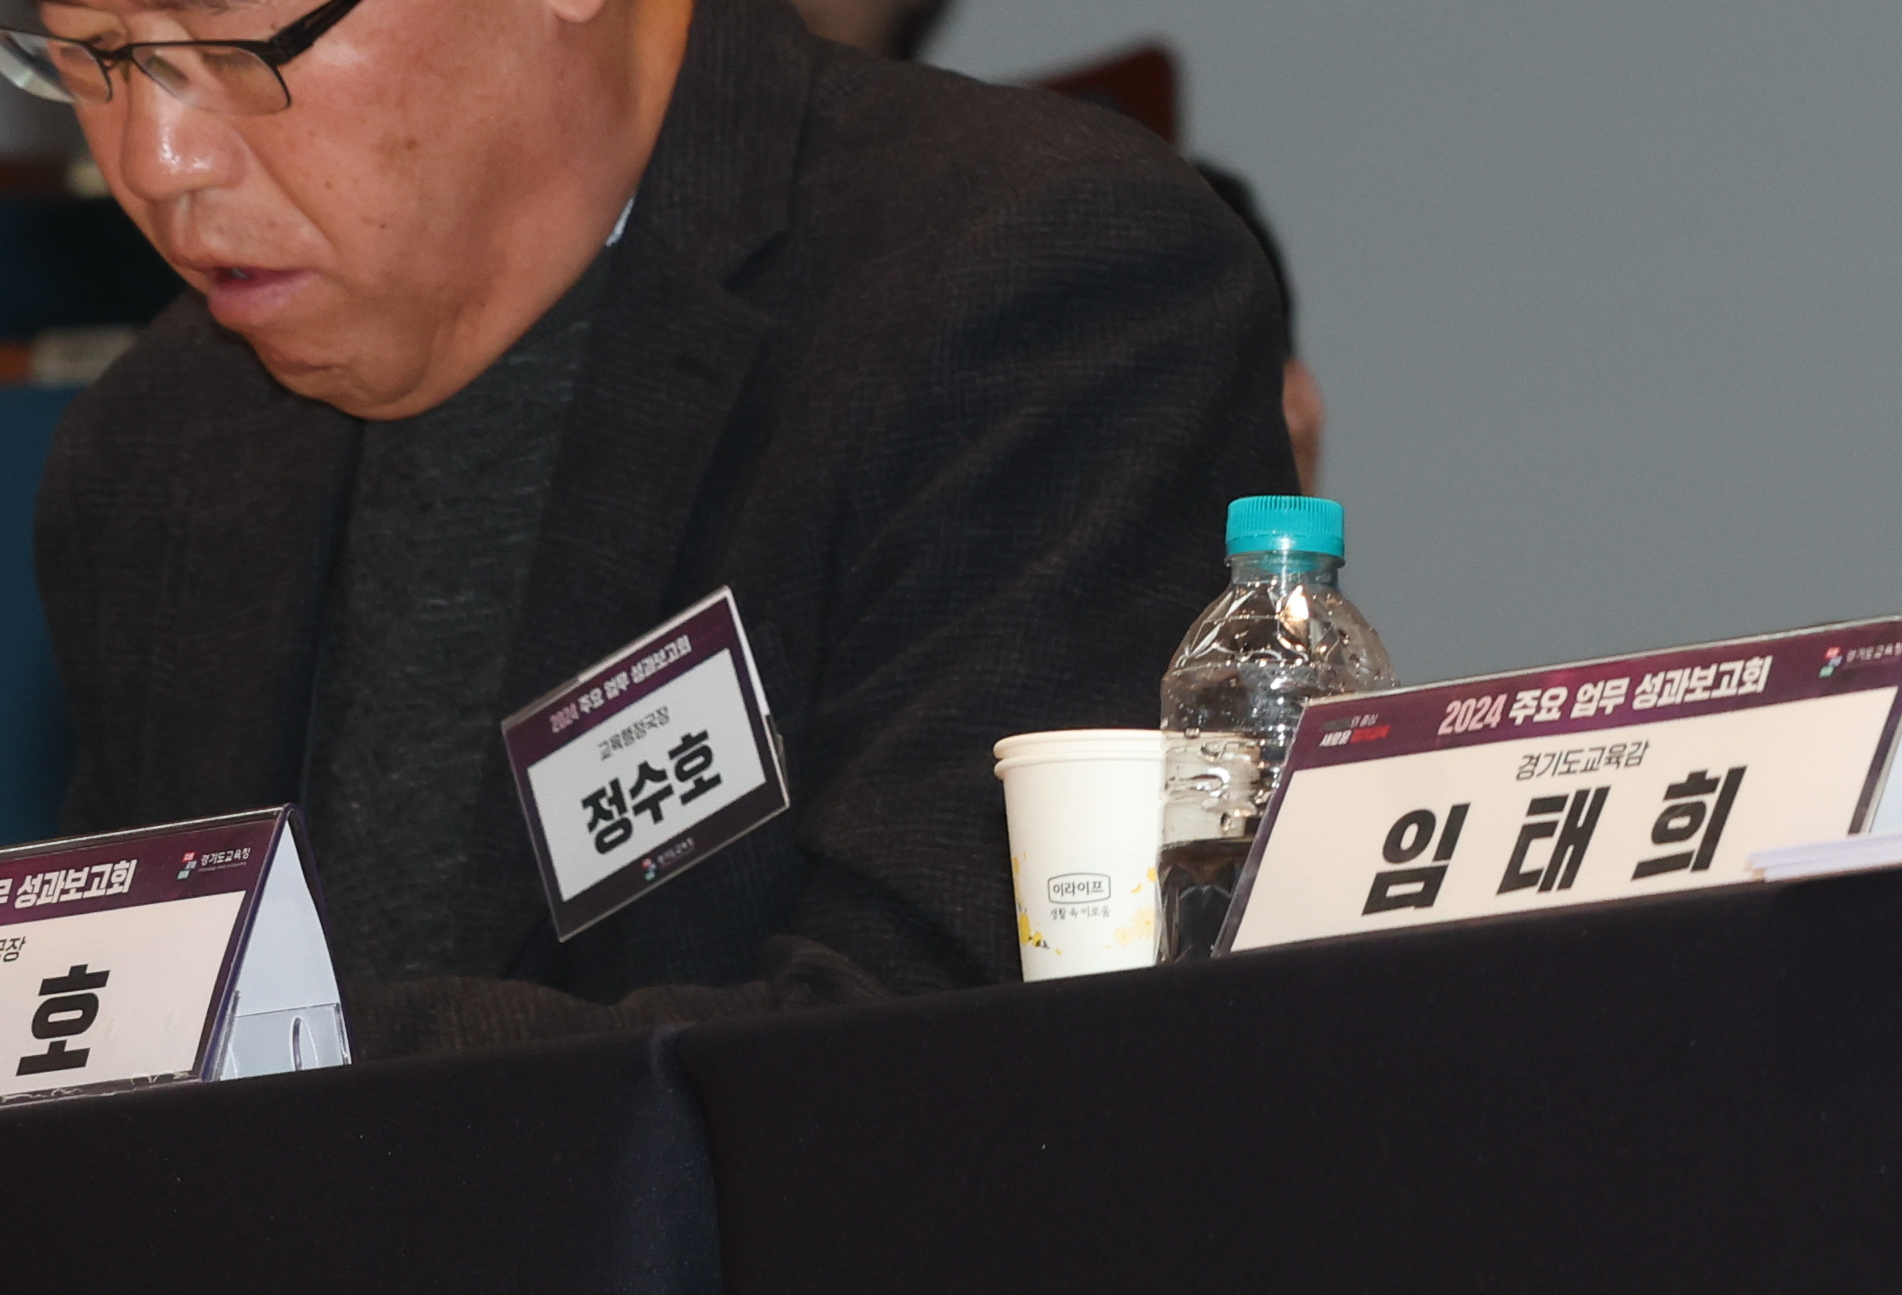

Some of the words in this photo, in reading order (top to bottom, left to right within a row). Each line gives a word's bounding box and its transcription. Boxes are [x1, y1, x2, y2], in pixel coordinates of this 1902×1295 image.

[1437, 693, 1507, 736] 2024
[1508, 687, 1568, 726] 주요
[1570, 675, 1627, 717] 업무
[1633, 655, 1773, 719] 성과보고회
[580, 730, 722, 854] 정수호
[1514, 739, 1650, 781] 경기도교육감
[14, 859, 138, 909] 성과보고회
[200, 847, 251, 866] 경기도교육청
[16, 964, 110, 1076] 호
